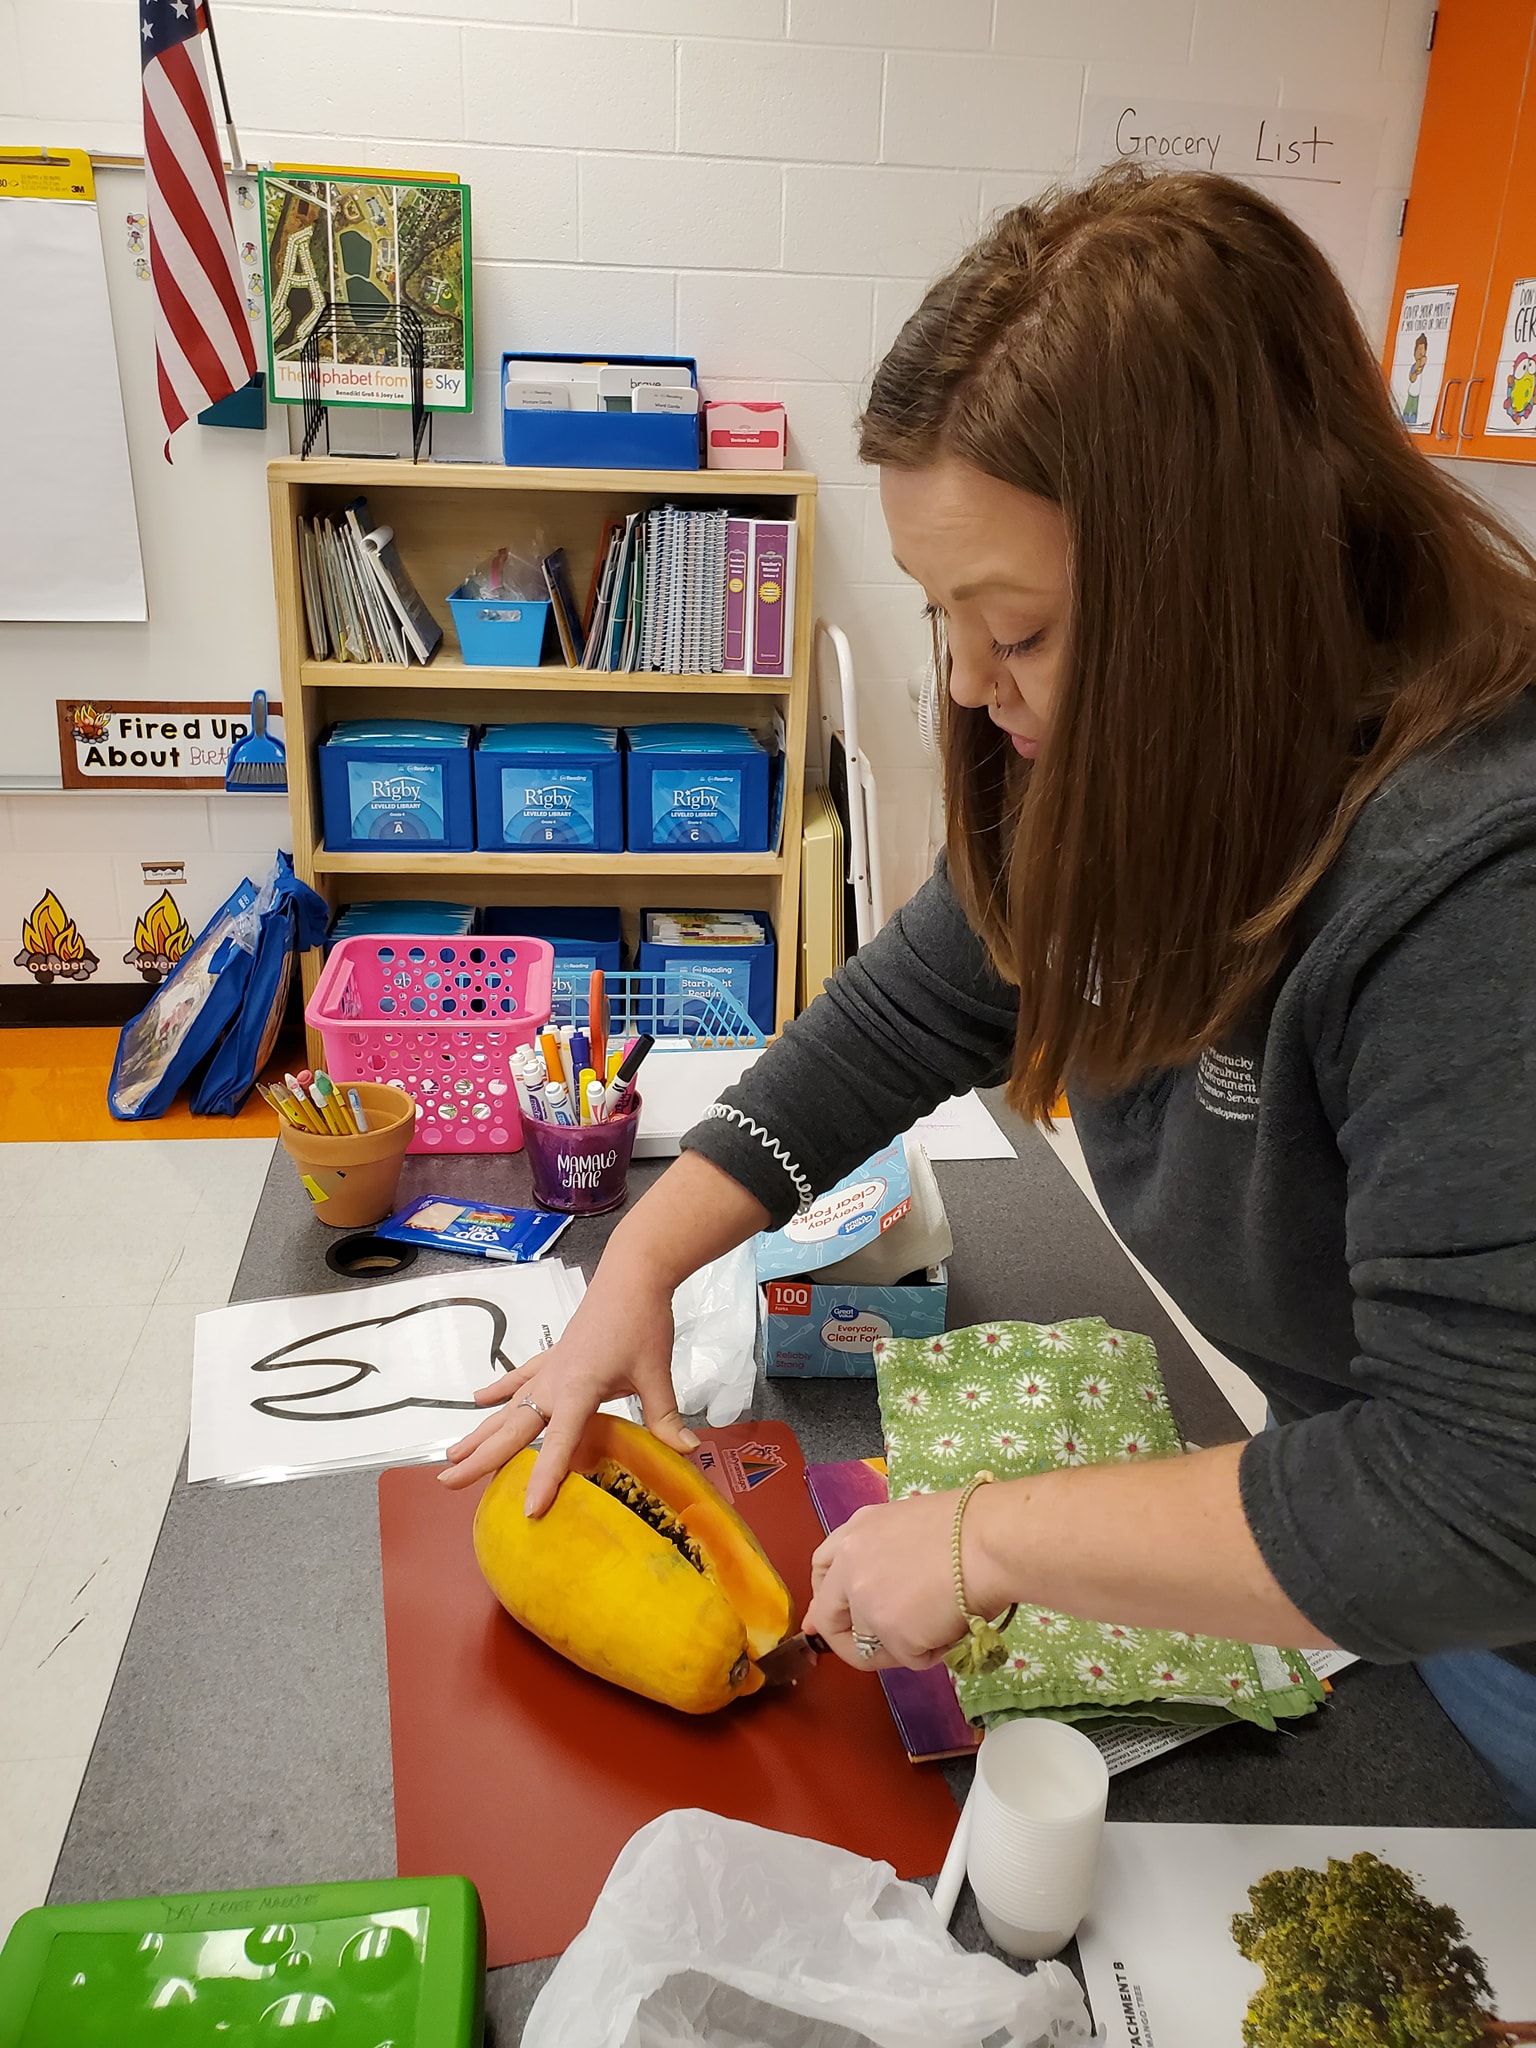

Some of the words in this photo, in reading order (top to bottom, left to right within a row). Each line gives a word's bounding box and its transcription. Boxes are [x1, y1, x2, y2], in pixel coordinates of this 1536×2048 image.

[1115, 108, 1221, 169] Grocery
[1255, 120, 1334, 164] List
[71, 185, 85, 193] 3M
[375, 373, 408, 387] from
[435, 374, 461, 393] Sky
[119, 718, 201, 740] Fired
[212, 718, 248, 743] Up
[84, 746, 180, 768] About
[371, 780, 420, 800] Rigby
[524, 789, 572, 809] Rigby
[672, 790, 718, 809] Rigby
[394, 823, 403, 833] A
[545, 831, 553, 840] B
[690, 831, 699, 841] C
[29, 959, 86, 972] October
[703, 966, 732, 974] Reading
[682, 979, 705, 987] Start
[836, 1185, 877, 1210] Clear
[791, 1206, 832, 1226] Forks
[808, 1201, 865, 1230] Everyday
[882, 1203, 910, 1229] 100
[775, 1287, 808, 1305] 100
[827, 1333, 857, 1342] Clear
[837, 1324, 878, 1333] Everyday
[776, 1351, 812, 1360] Reliably
[775, 1361, 805, 1369] Strong
[700, 1452, 716, 1471] UK
[1113, 1962, 1124, 1970] B
[1133, 1984, 1145, 2008] TREE
[1115, 1973, 1142, 2048] ACHMENT
